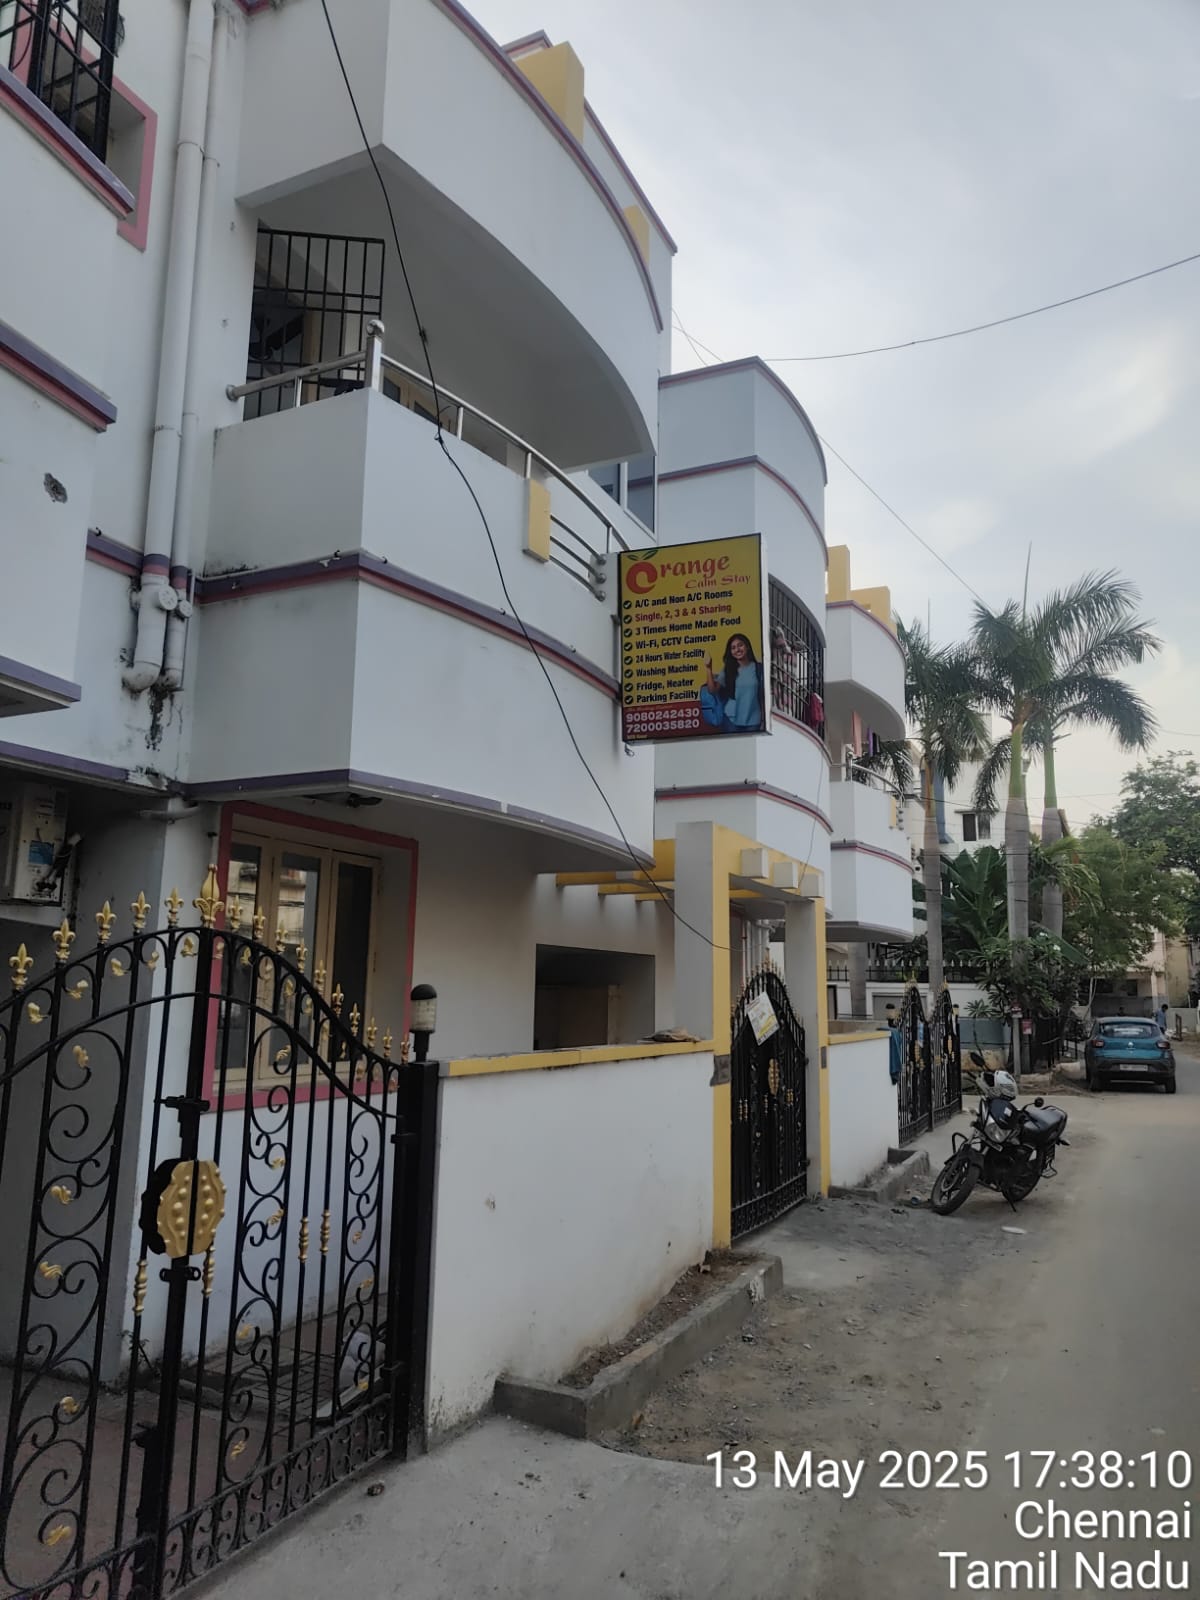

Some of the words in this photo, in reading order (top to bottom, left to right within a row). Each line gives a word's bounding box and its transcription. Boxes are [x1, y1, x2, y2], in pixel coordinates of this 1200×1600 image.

[626, 556, 729, 594] Orange
[721, 575, 751, 585] Stay
[635, 599, 649, 608] A/C
[652, 597, 666, 606] and
[669, 595, 685, 604] Non
[687, 592, 702, 601] A/C
[704, 590, 733, 599] Rooms
[635, 611, 663, 622] Single,
[665, 610, 672, 619] 2,
[674, 609, 680, 617] 3
[682, 608, 688, 616] &
[691, 607, 696, 616] 4
[699, 604, 731, 615] Sharing
[643, 625, 667, 635] Times
[669, 623, 692, 632] Home
[695, 619, 718, 629] Made
[720, 616, 741, 626] Food
[636, 639, 659, 649] Wi-Fi,
[661, 637, 682, 646] CCTV
[684, 635, 716, 644] Camera
[636, 655, 643, 663] 24
[645, 653, 663, 662] Hours
[664, 651, 681, 660] Water
[683, 649, 705, 659] Facility
[636, 667, 666, 677] Washing
[668, 664, 698, 674] Machine
[636, 681, 665, 691] Fridge,
[667, 678, 694, 688] Heater
[636, 693, 667, 703] Parking
[669, 690, 698, 700] Facility
[626, 708, 699, 722] 9080242430
[626, 719, 699, 733] 7200035820
